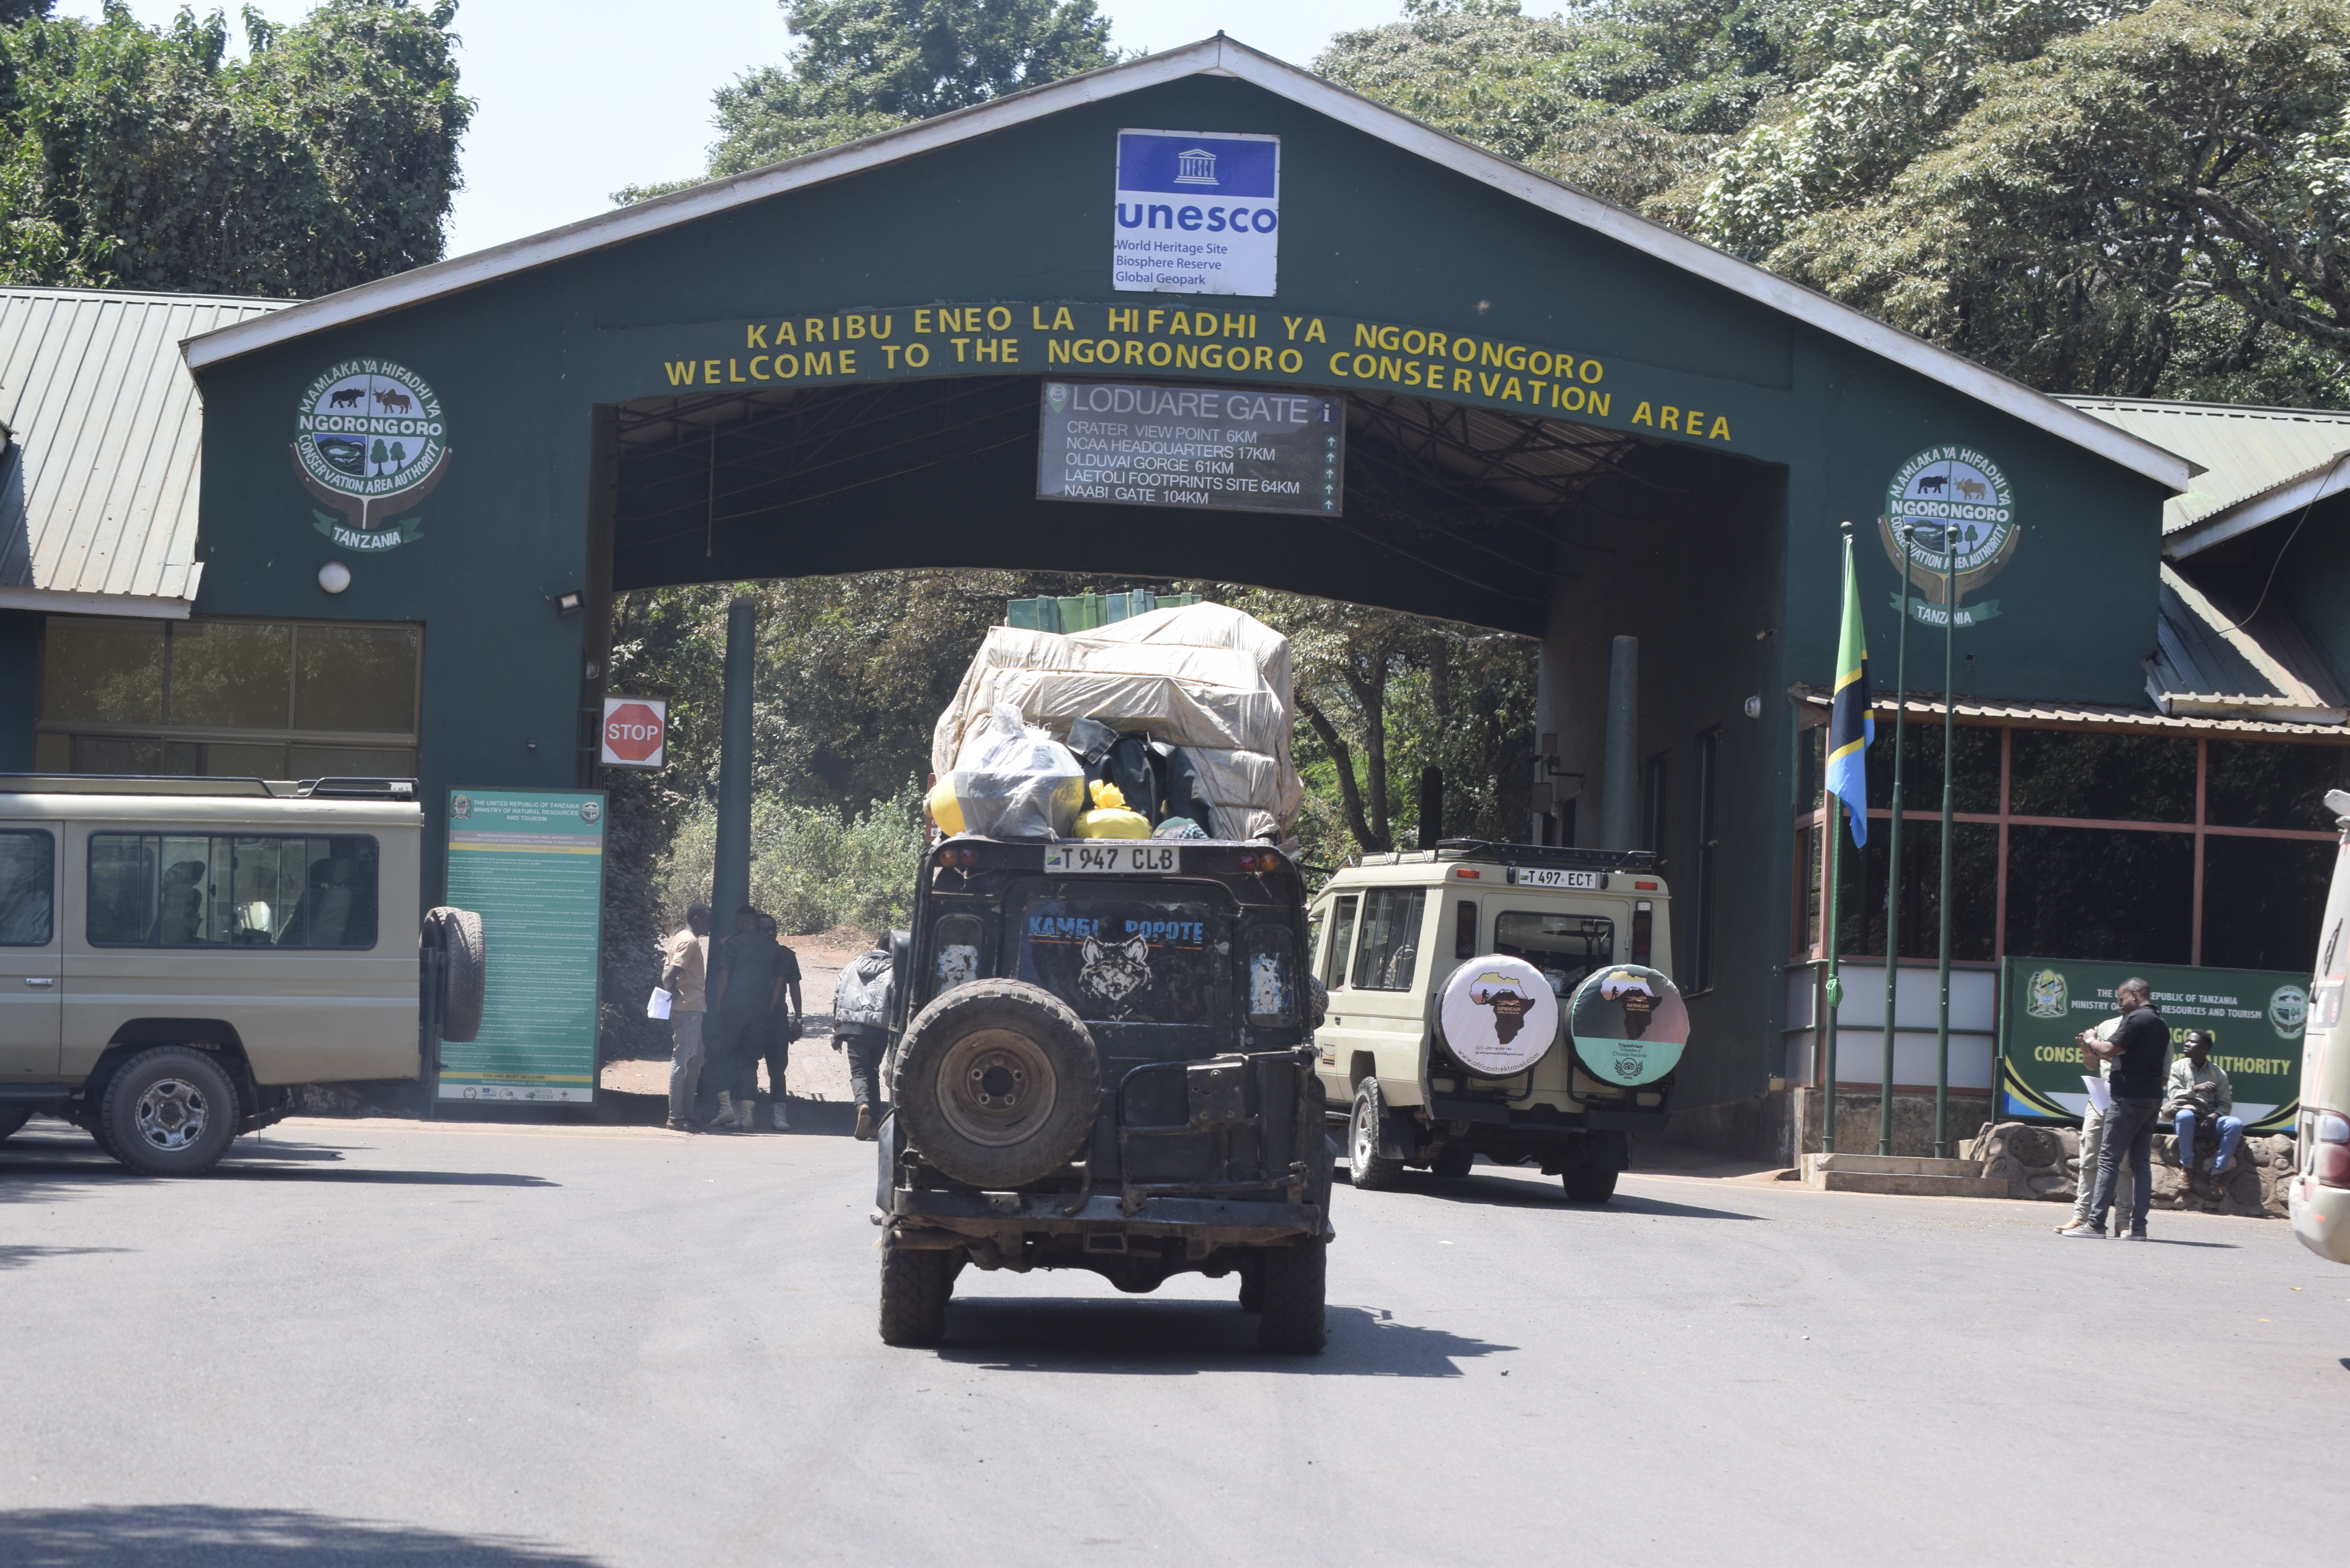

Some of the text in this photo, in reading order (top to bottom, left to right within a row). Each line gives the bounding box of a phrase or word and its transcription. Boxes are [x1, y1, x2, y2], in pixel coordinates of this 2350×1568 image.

[1180, 158, 1214, 177] UNESCO
[1118, 203, 1277, 233] unesco
[1116, 239, 1227, 255] World Heritage Site
[1116, 256, 1222, 269] Biosphere Reserve
[1116, 271, 1205, 286] Global Geopark
[747, 306, 1603, 384] KARIBU ENEO LA HIFADHI YA NGORONGORO
[299, 360, 441, 418] MAMLAKA YA HIFADHI YA
[664, 338, 1731, 441] WELCOME TO THE NGORONGORO CONSERVATION AREA
[1073, 386, 1219, 418] LODUARE
[1227, 395, 1308, 423] GATE
[299, 416, 442, 435] NGORONGORO
[1067, 421, 1257, 443] CRATER VIEW POINT 6KM
[1067, 437, 1275, 460] NCAA HEADQUARTERS 17KM
[298, 434, 439, 493] CONSERVATION AREA AUTHORITY
[1066, 453, 1234, 474] OLDUVAI GORGE 61KM
[1065, 469, 1299, 494] LAETOLI FOOTPRINTS SITE 64KM
[1890, 447, 2011, 506] MAMLAKA YA HIFADHI YA
[1064, 485, 1208, 504] NAABI GATE 104KM
[1892, 500, 2009, 522] NGORONGORO
[333, 527, 401, 548] TANZANIA
[1969, 524, 2007, 569] AUTHORITY
[608, 723, 658, 741] STOP
[1062, 848, 1173, 870] T 947 CLB
[1528, 871, 1592, 886] T 497 ECT
[2097, 989, 2113, 997] THE
[2198, 995, 2238, 1005] TANZANIA
[2071, 1000, 2108, 1009] MINISTRY
[2161, 1005, 2206, 1015] RESOURCES
[2208, 1008, 2225, 1017] AND
[2228, 1009, 2262, 1019] TOURISM
[1458, 1050, 1539, 1072] www.africantrektravel.com
